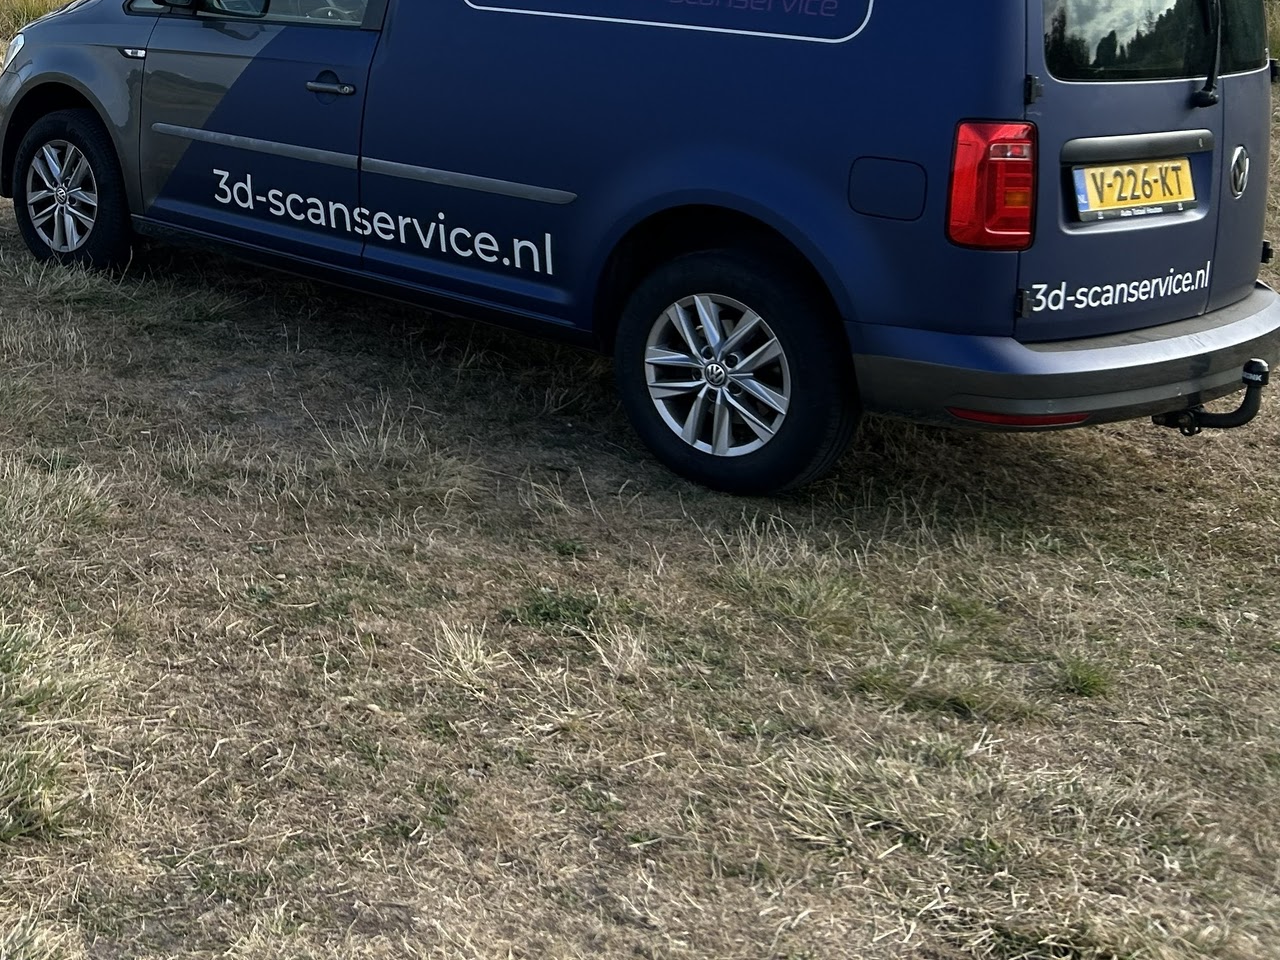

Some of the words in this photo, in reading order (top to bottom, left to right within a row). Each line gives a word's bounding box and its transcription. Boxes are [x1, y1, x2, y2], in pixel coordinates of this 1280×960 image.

[1091, 165, 1182, 203] V-226-KT
[212, 168, 554, 275] 3d-scanservice.nl
[1031, 260, 1211, 312] 3d-scanservice.nl
